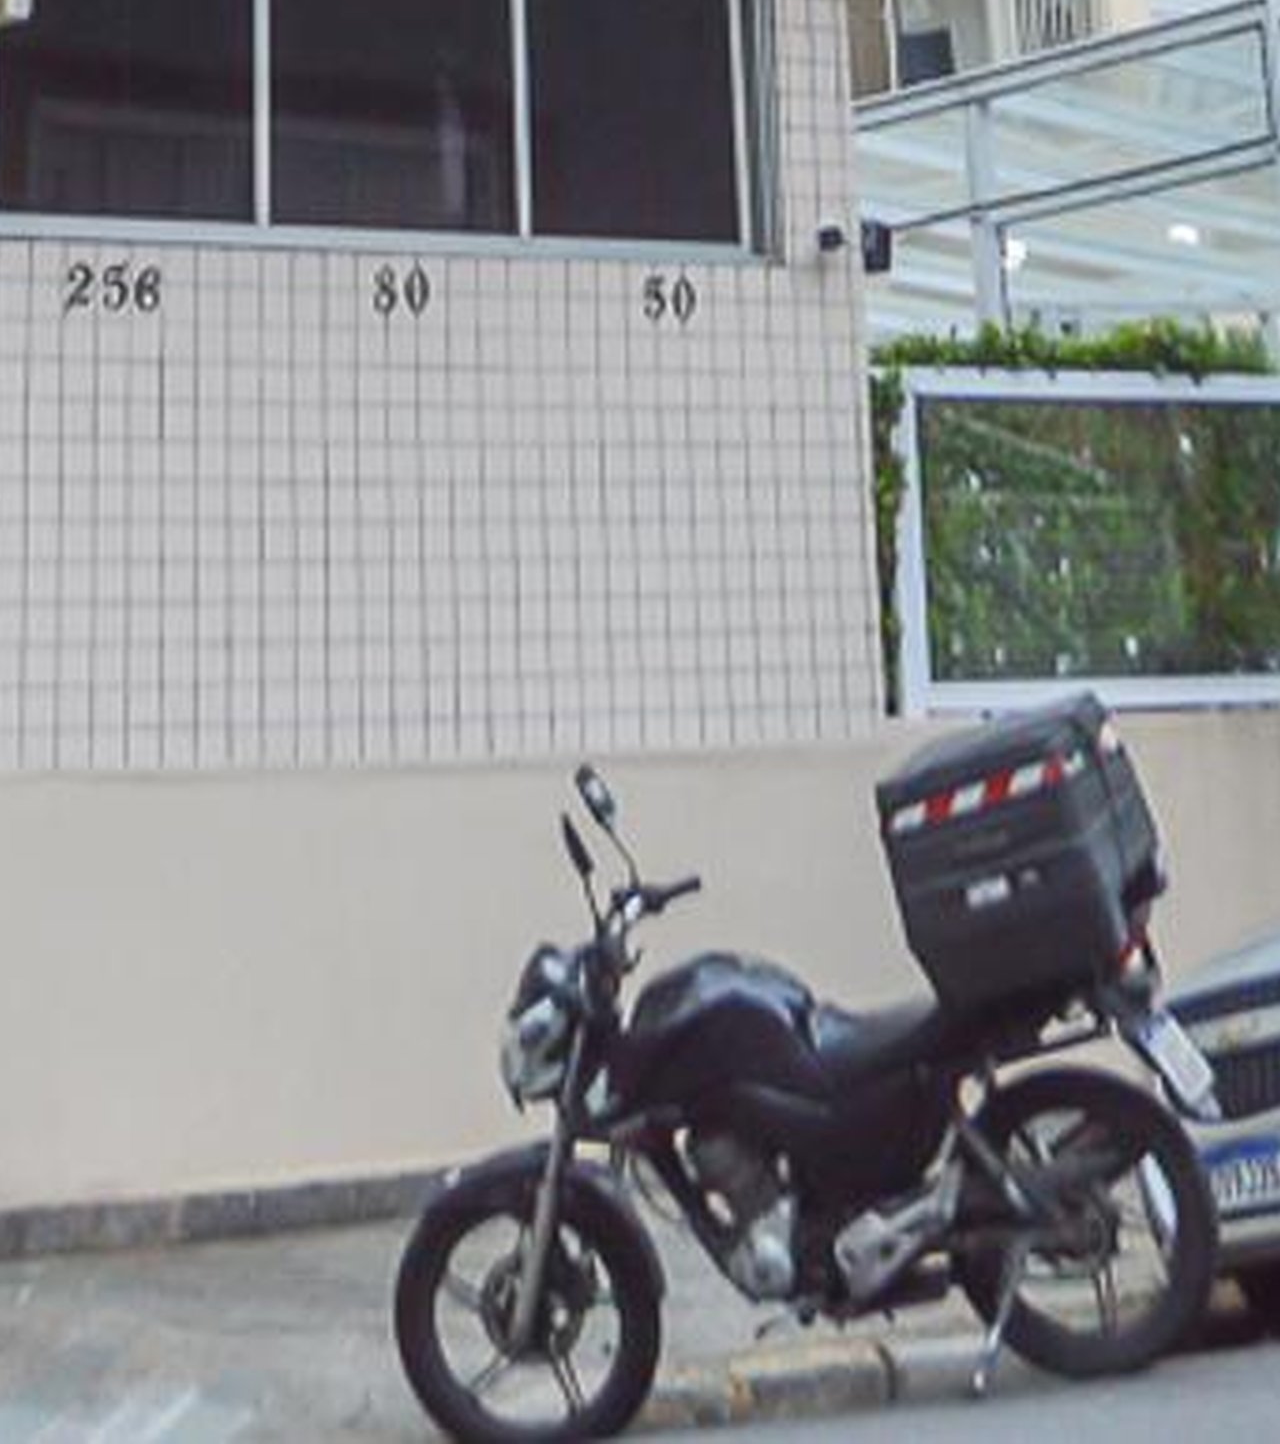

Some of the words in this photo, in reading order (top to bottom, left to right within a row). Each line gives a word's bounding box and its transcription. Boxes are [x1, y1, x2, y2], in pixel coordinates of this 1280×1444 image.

[64, 262, 161, 314] 256
[373, 261, 430, 317] 80
[643, 273, 696, 323] 50
